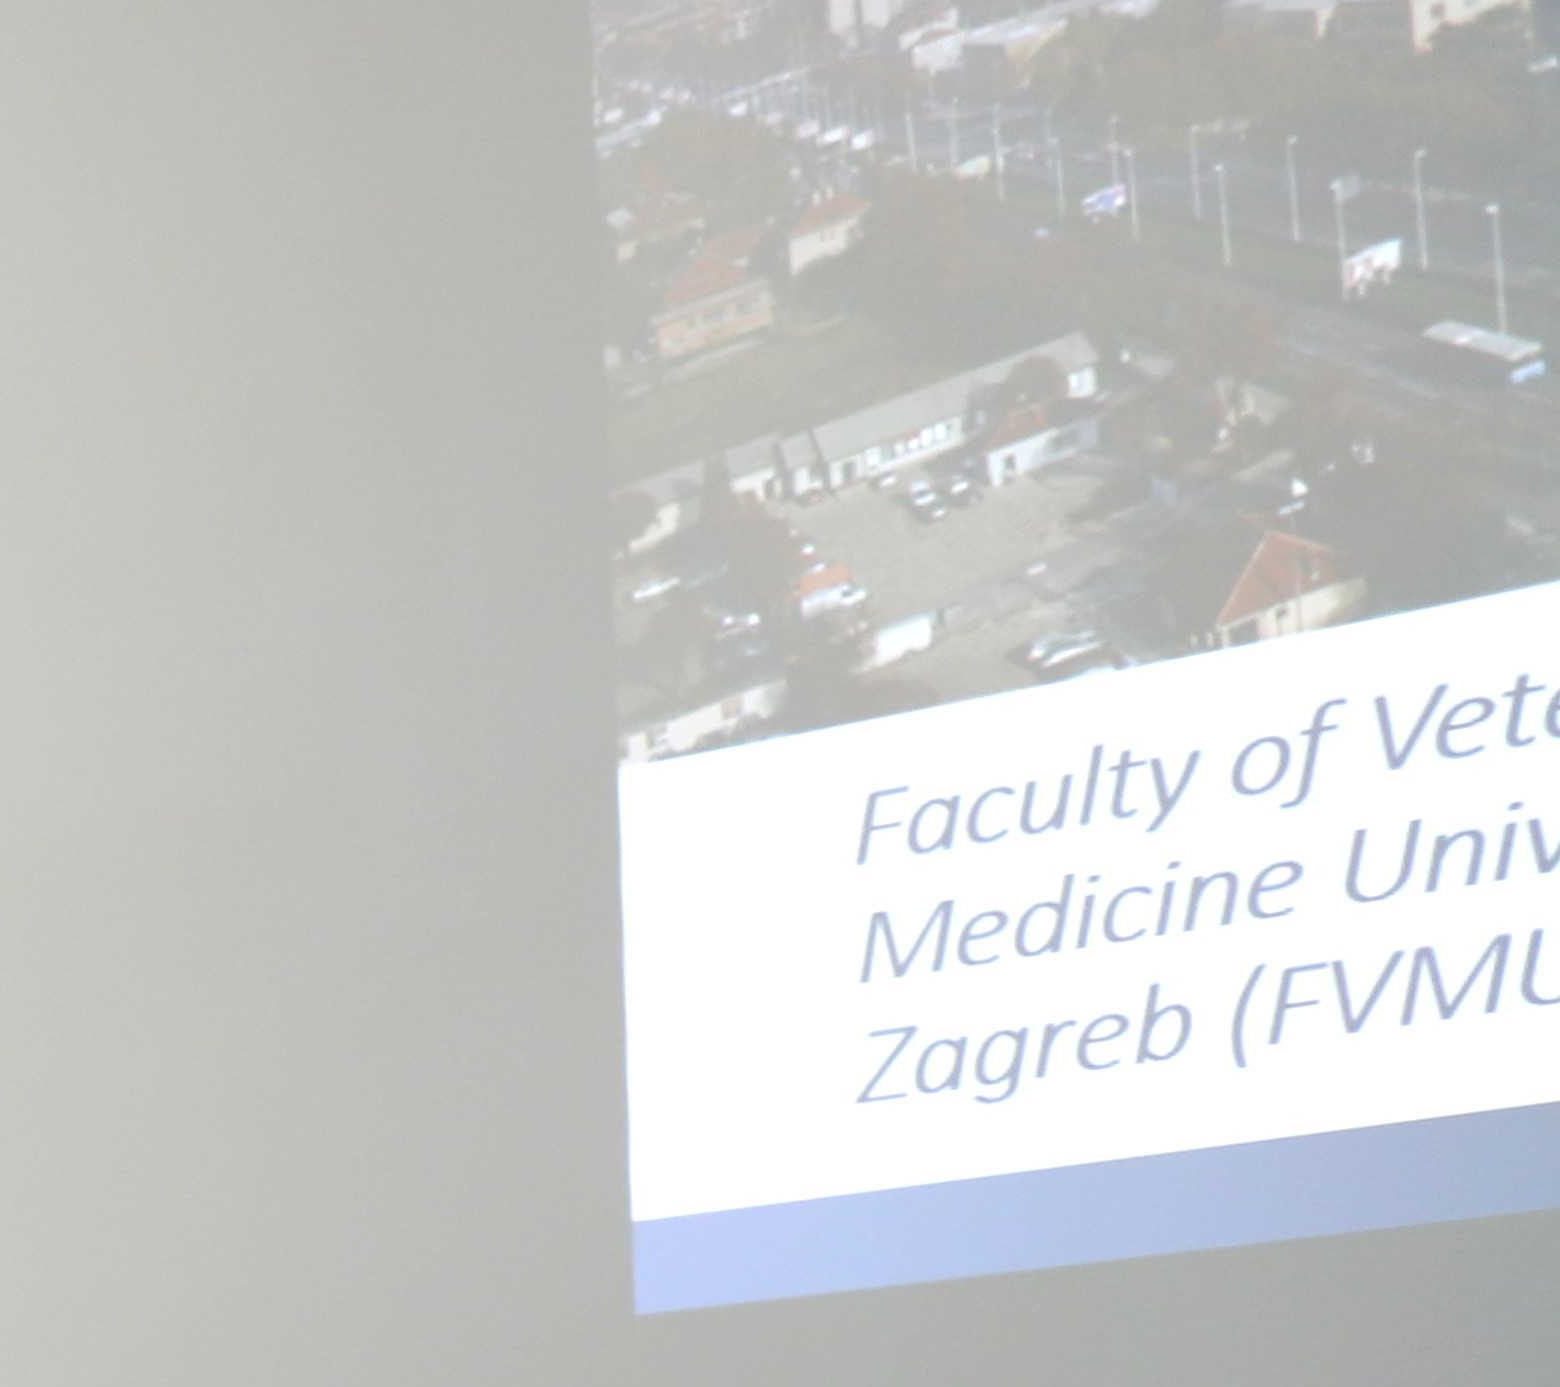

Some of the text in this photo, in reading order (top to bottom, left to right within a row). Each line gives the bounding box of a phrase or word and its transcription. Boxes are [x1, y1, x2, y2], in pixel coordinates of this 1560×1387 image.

[855, 673, 1560, 866] Faculty of Vet
[859, 862, 1304, 984] Medicine
[855, 983, 1194, 1105] Zagreb
